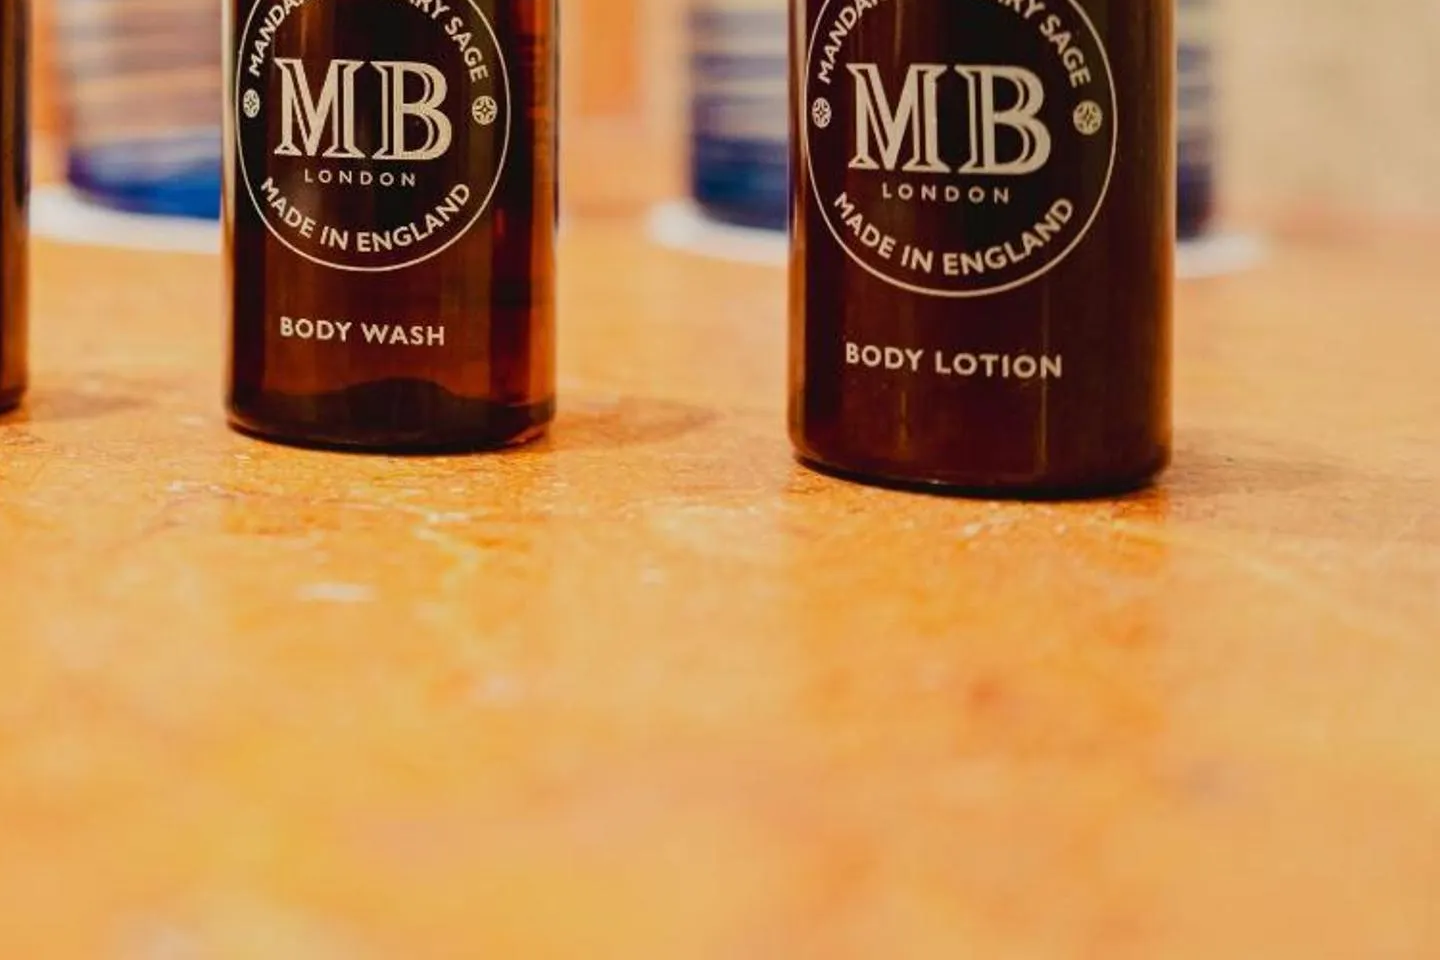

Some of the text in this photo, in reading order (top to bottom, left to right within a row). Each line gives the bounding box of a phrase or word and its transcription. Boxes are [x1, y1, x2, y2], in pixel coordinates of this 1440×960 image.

[444, 17, 489, 83] SAGE
[1039, 14, 1091, 88] SAGE
[273, 57, 453, 160] MB
[846, 62, 1052, 176] MB
[304, 170, 417, 188] LONDON
[882, 182, 1010, 205] LONDON
[260, 176, 470, 253] MADE IN ENGLAND
[833, 191, 1074, 277] MADE IN ENGLAND
[279, 316, 446, 346] BODY WASH
[845, 342, 1063, 379] BODY LOTION
